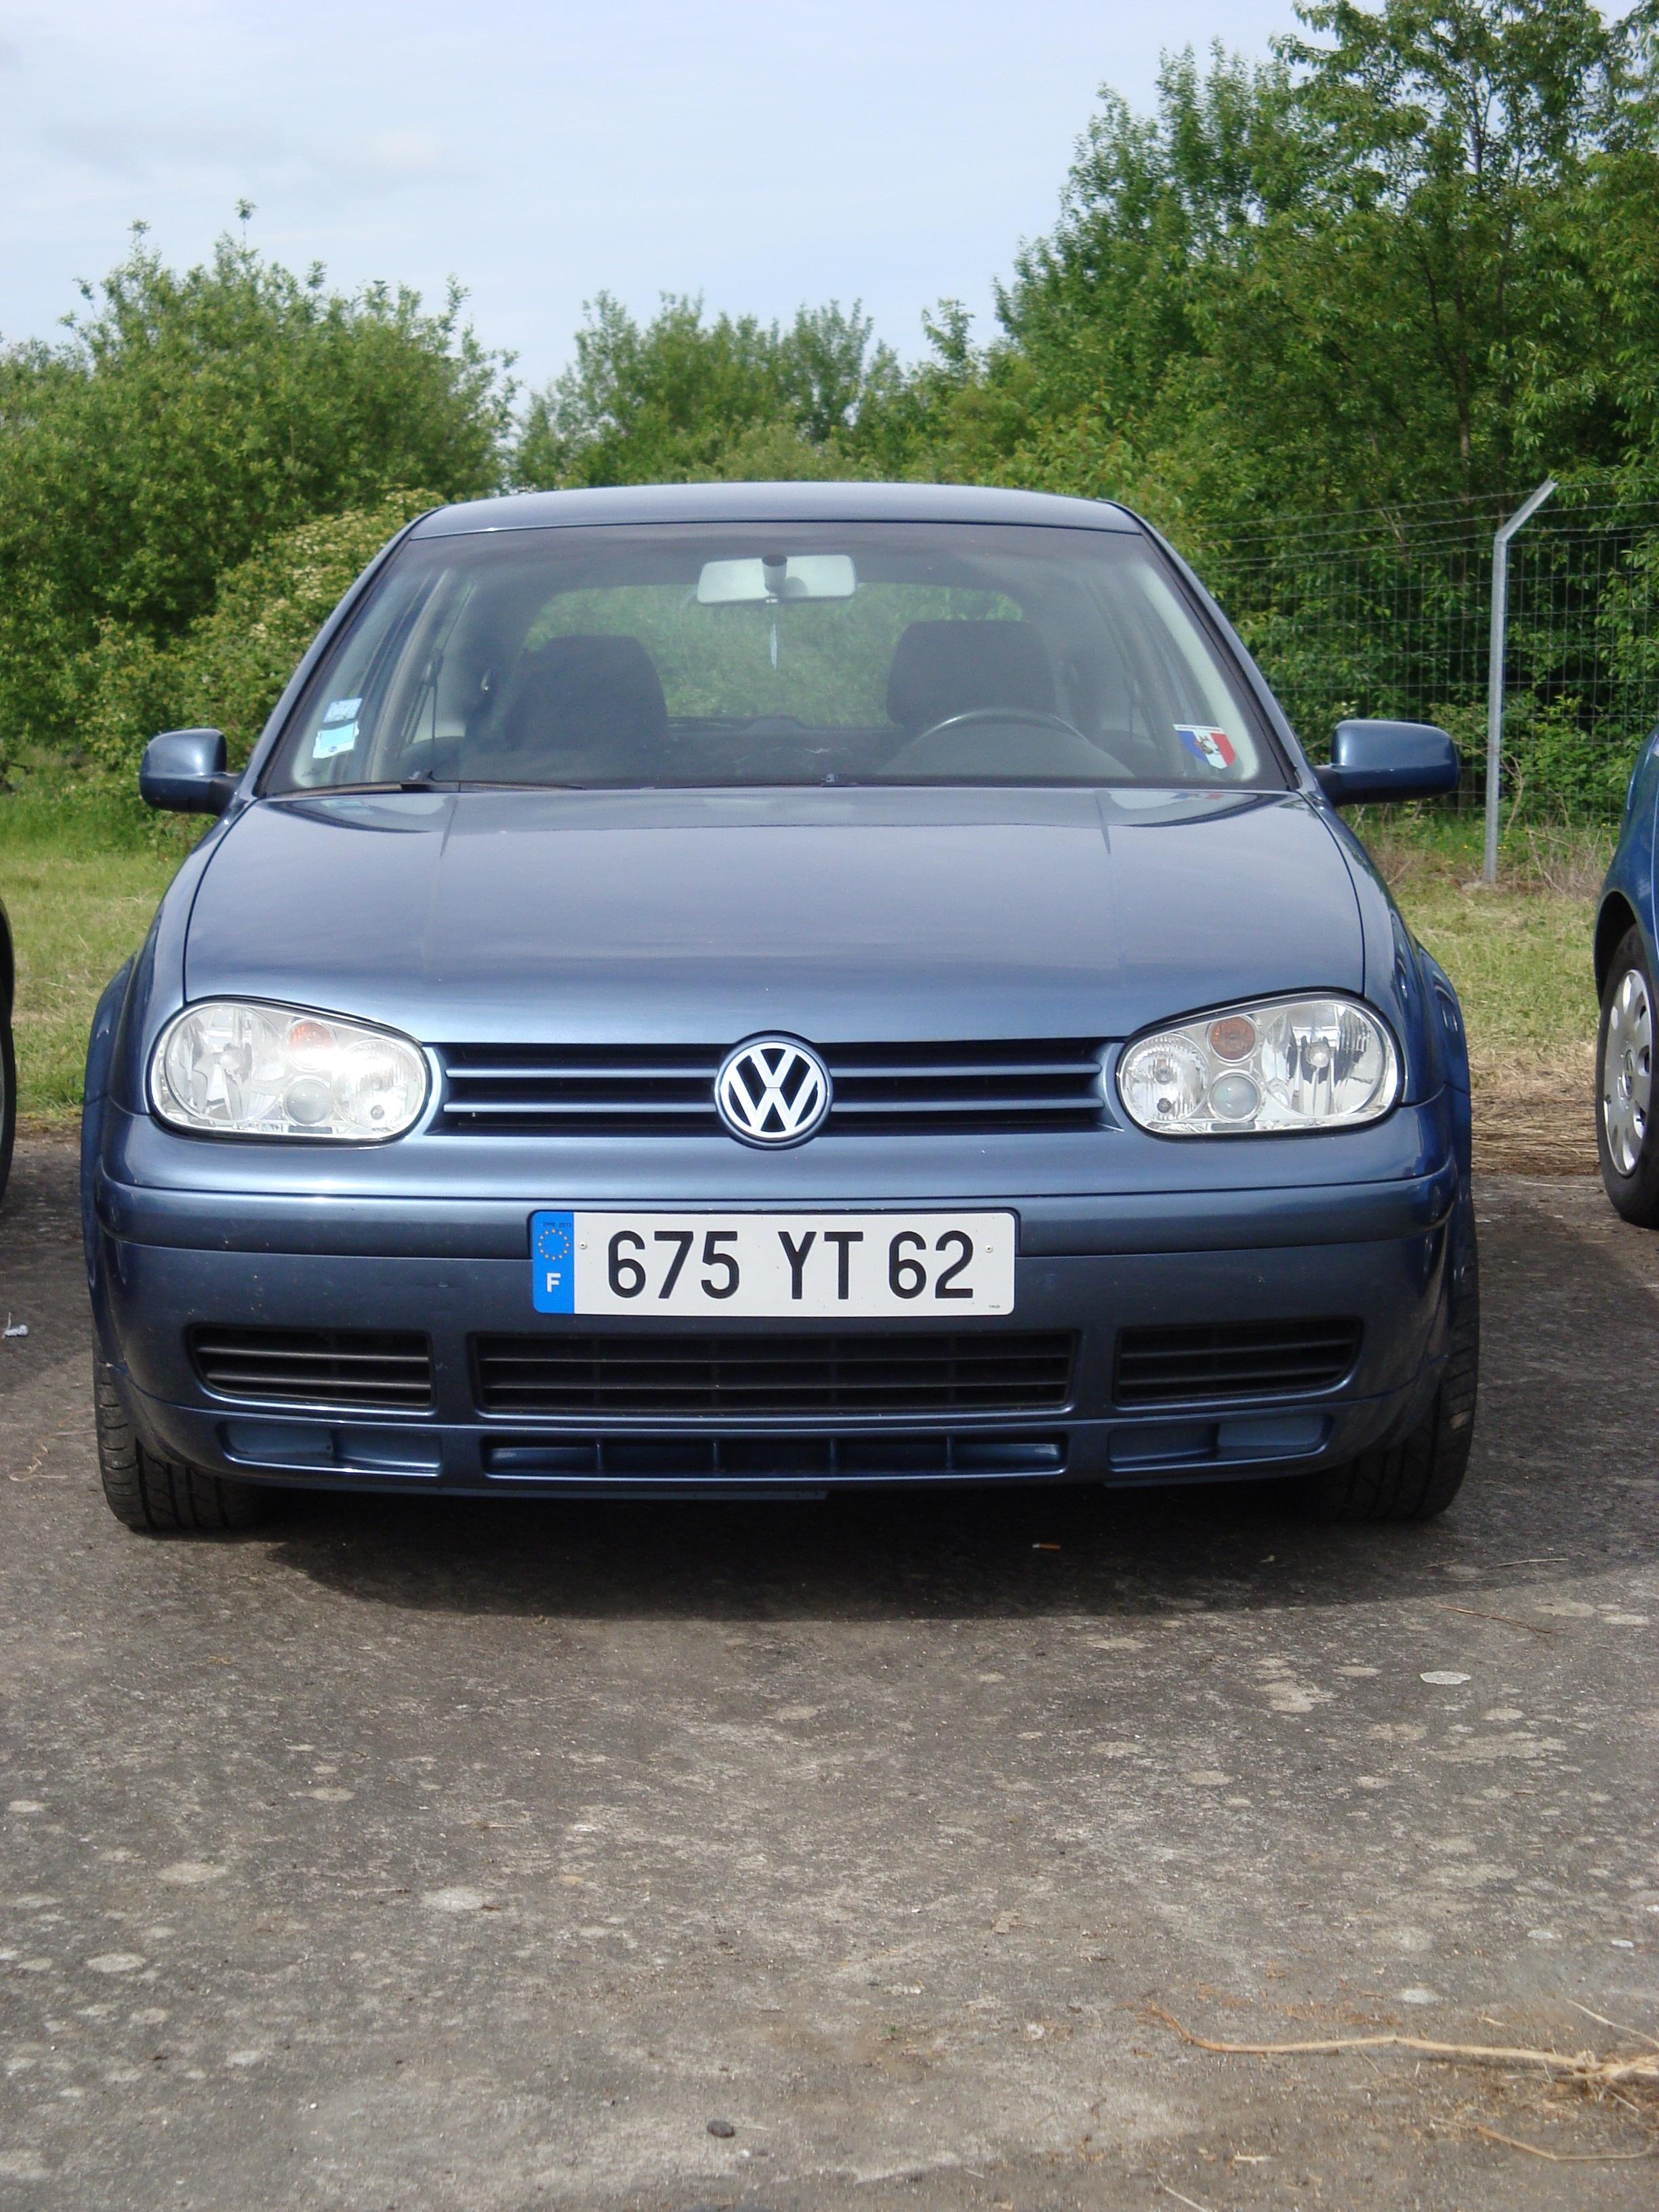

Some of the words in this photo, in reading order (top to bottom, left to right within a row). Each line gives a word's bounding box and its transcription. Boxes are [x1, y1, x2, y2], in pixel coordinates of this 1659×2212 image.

[722, 1044, 823, 1136] VW
[546, 1272, 561, 1292] F
[608, 1230, 739, 1299] 675
[777, 1231, 863, 1300] YT
[888, 1230, 974, 1299] 62
